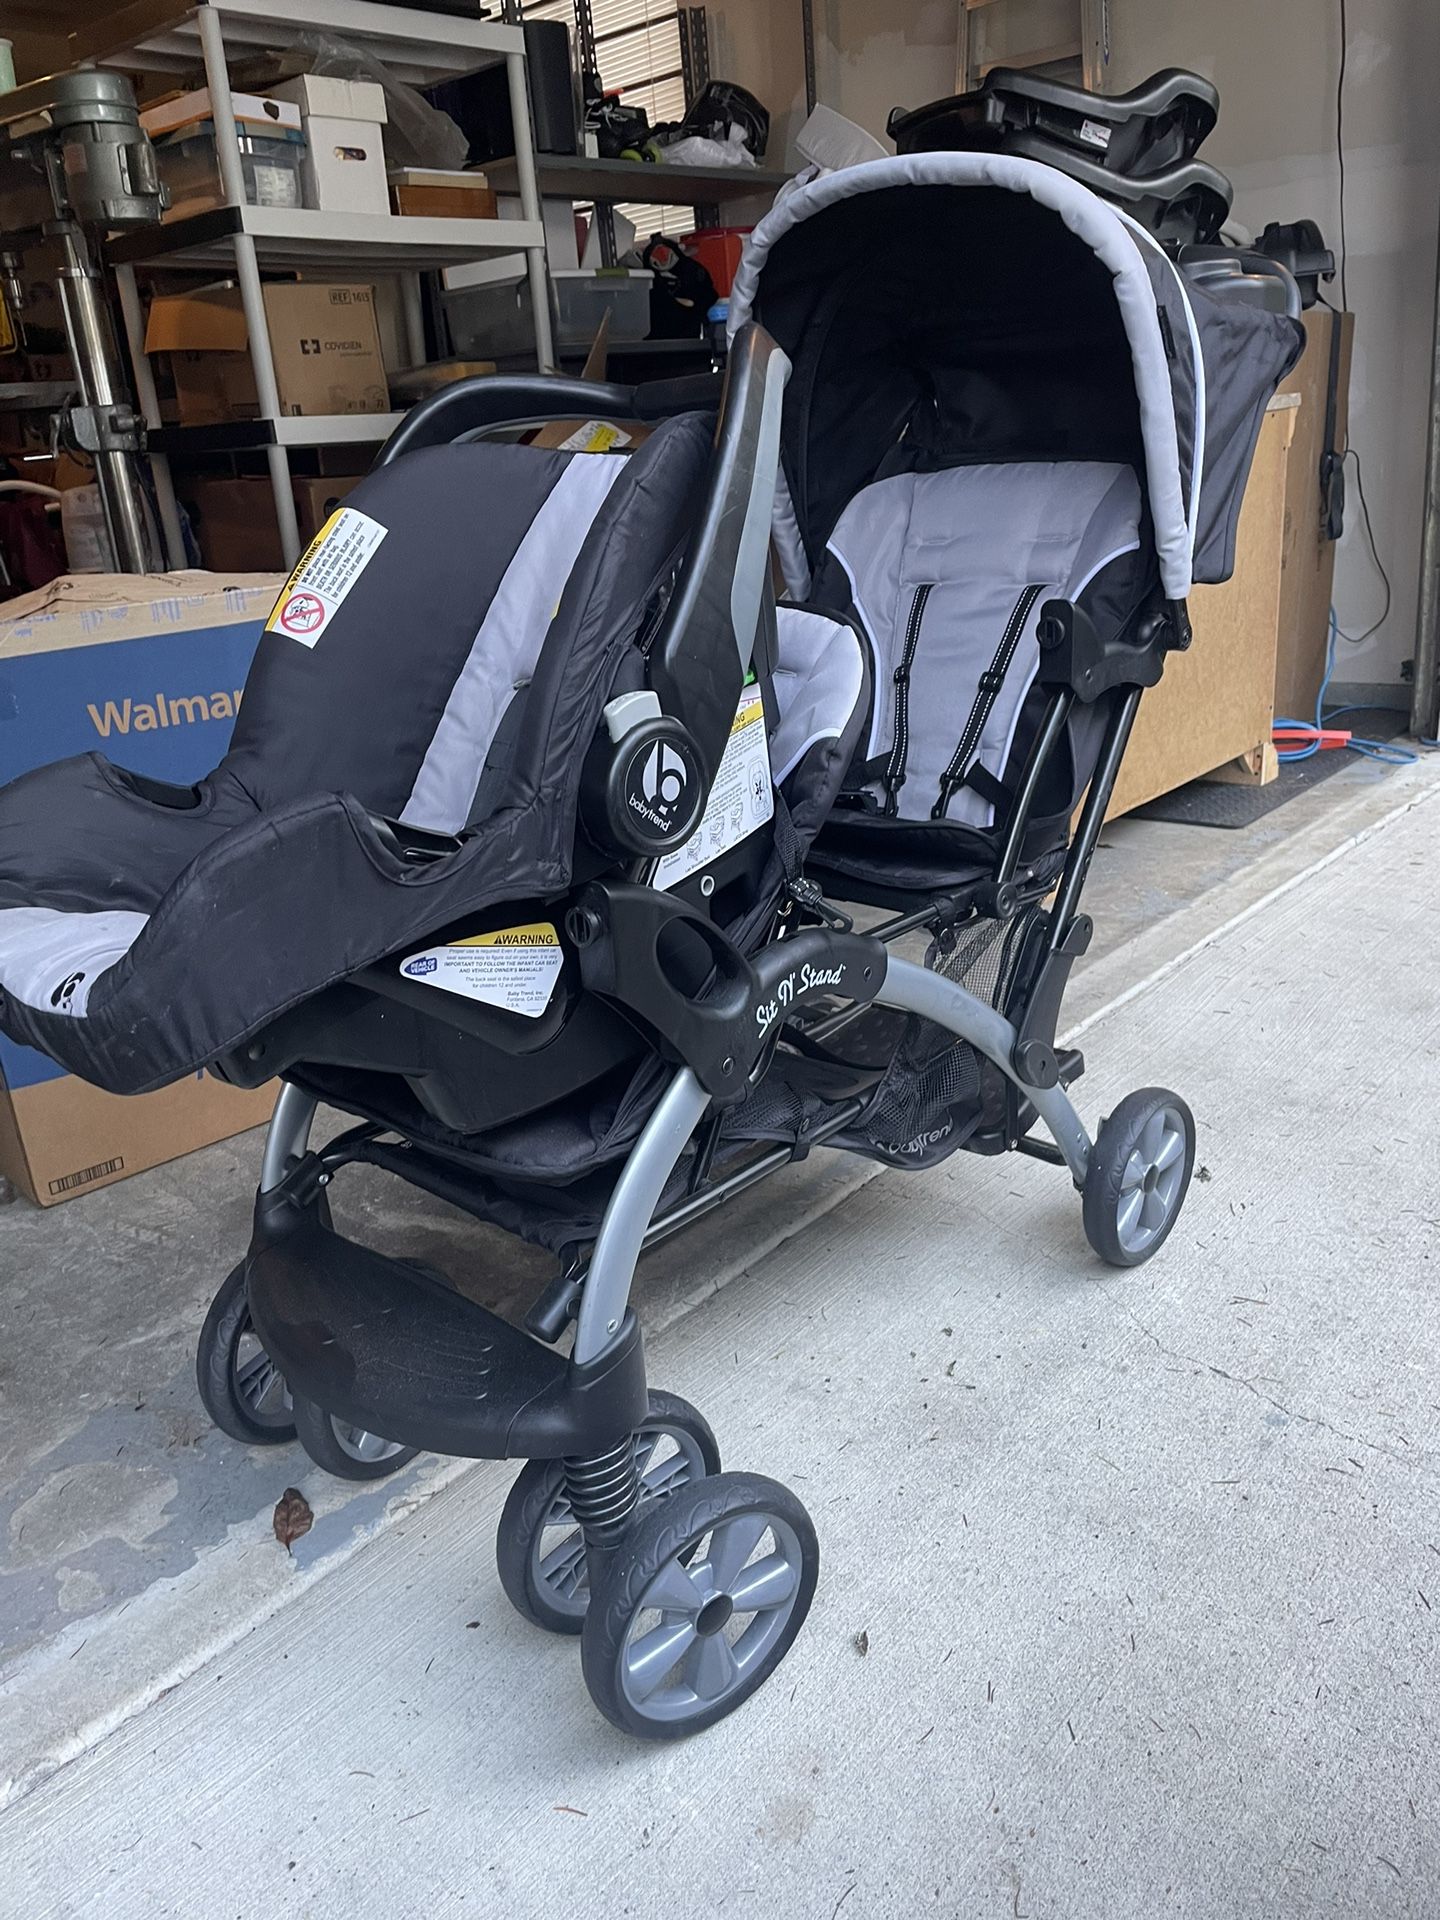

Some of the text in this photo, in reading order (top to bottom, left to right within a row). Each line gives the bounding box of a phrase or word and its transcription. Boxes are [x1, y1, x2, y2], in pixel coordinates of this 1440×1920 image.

[291, 540, 322, 583] WARNING
[86, 690, 243, 737] Walmar
[629, 793, 671, 832] babytrend
[502, 934, 553, 945] WARNING
[756, 1000, 779, 1039] Sit
[797, 963, 843, 995] Stand
